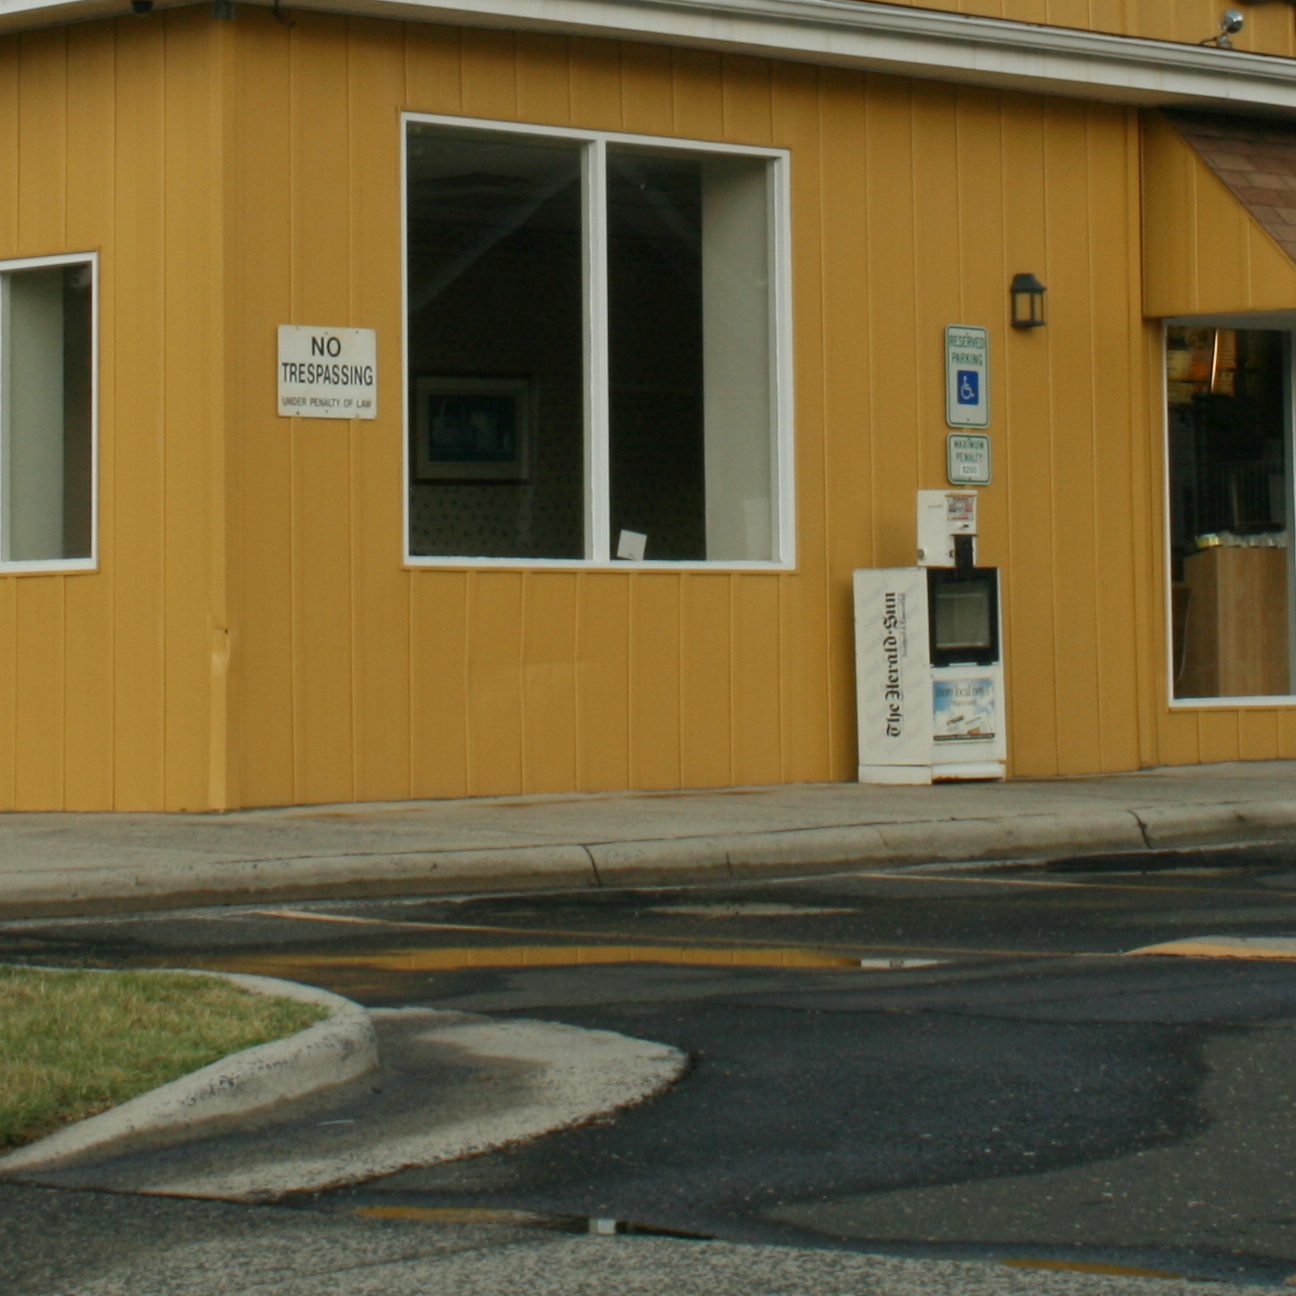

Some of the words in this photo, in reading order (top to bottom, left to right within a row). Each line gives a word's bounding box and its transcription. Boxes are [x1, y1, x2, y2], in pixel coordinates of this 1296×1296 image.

[311, 336, 342, 357] NO
[952, 351, 984, 366] PARKING
[282, 362, 373, 386] TRESPASSING
[282, 396, 307, 406] UNDER
[309, 397, 340, 408] PENALTY
[344, 399, 354, 408] OF
[356, 399, 372, 409] LAW
[886, 704, 902, 737] The
